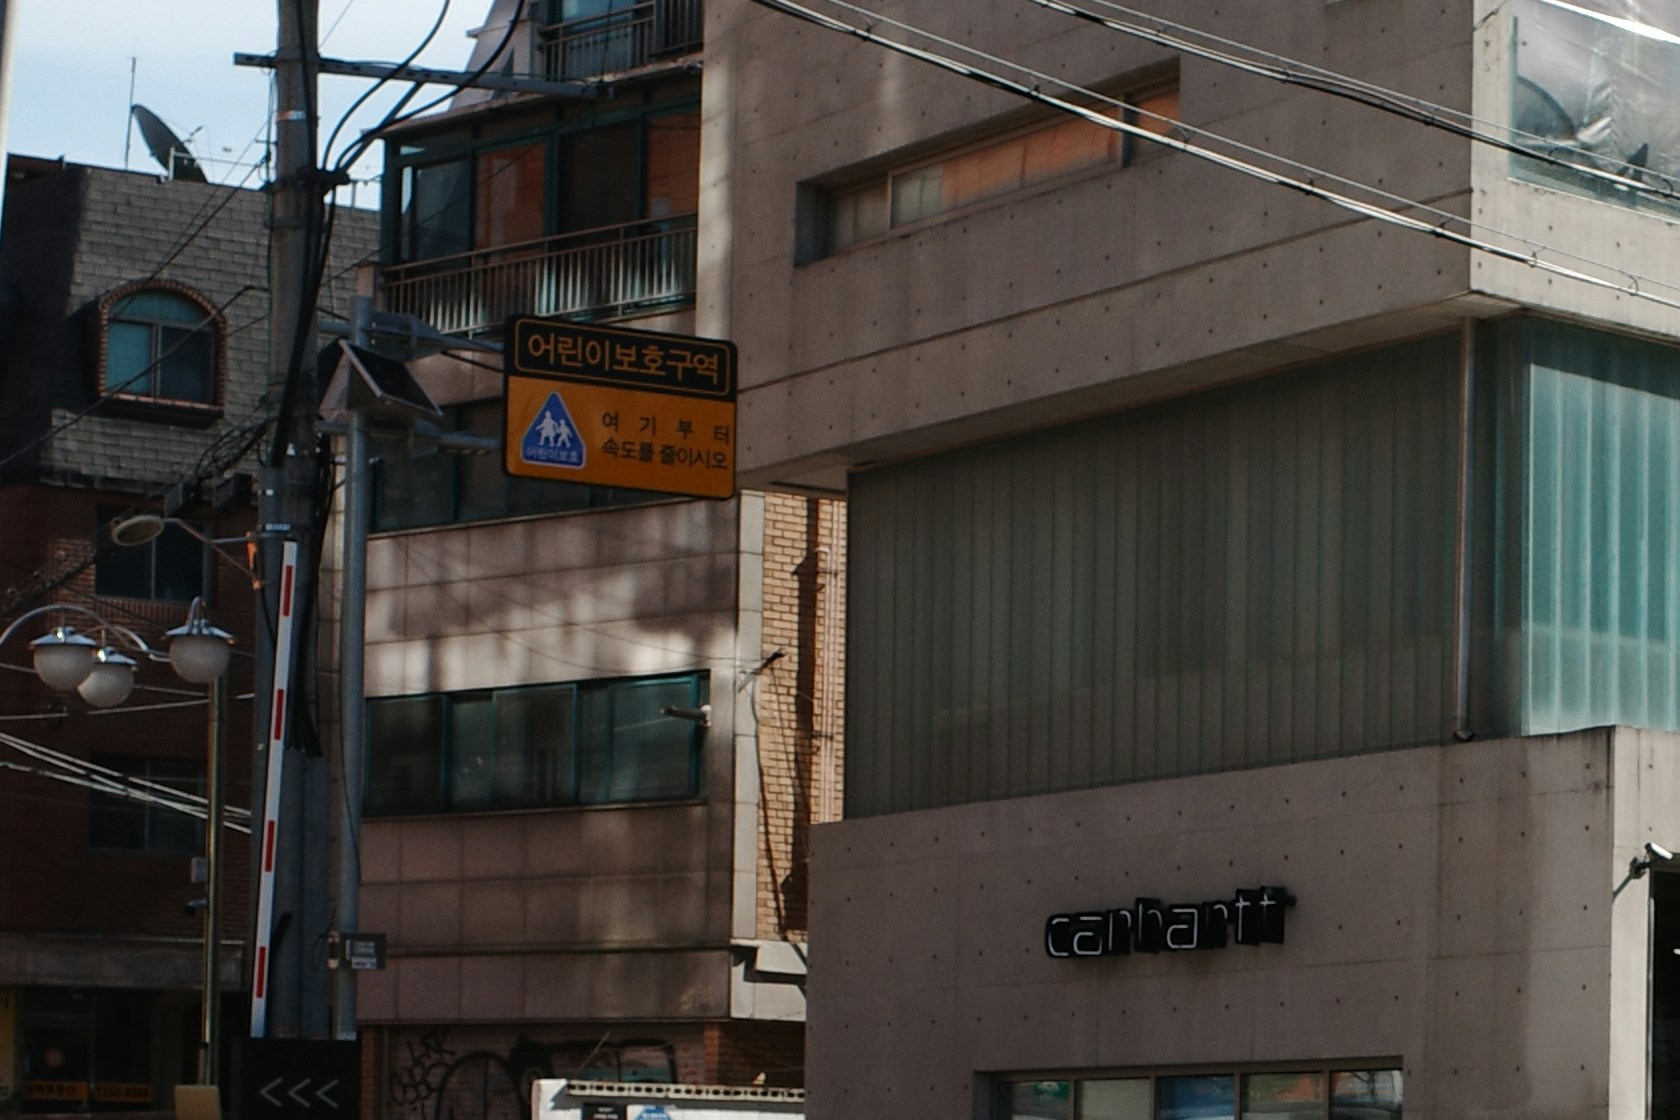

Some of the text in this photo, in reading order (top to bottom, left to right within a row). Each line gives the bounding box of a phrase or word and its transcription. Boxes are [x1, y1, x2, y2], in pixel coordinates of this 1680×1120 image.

[527, 333, 719, 385] 어린이보호구역
[602, 438, 728, 470] 속도를 줄이시오
